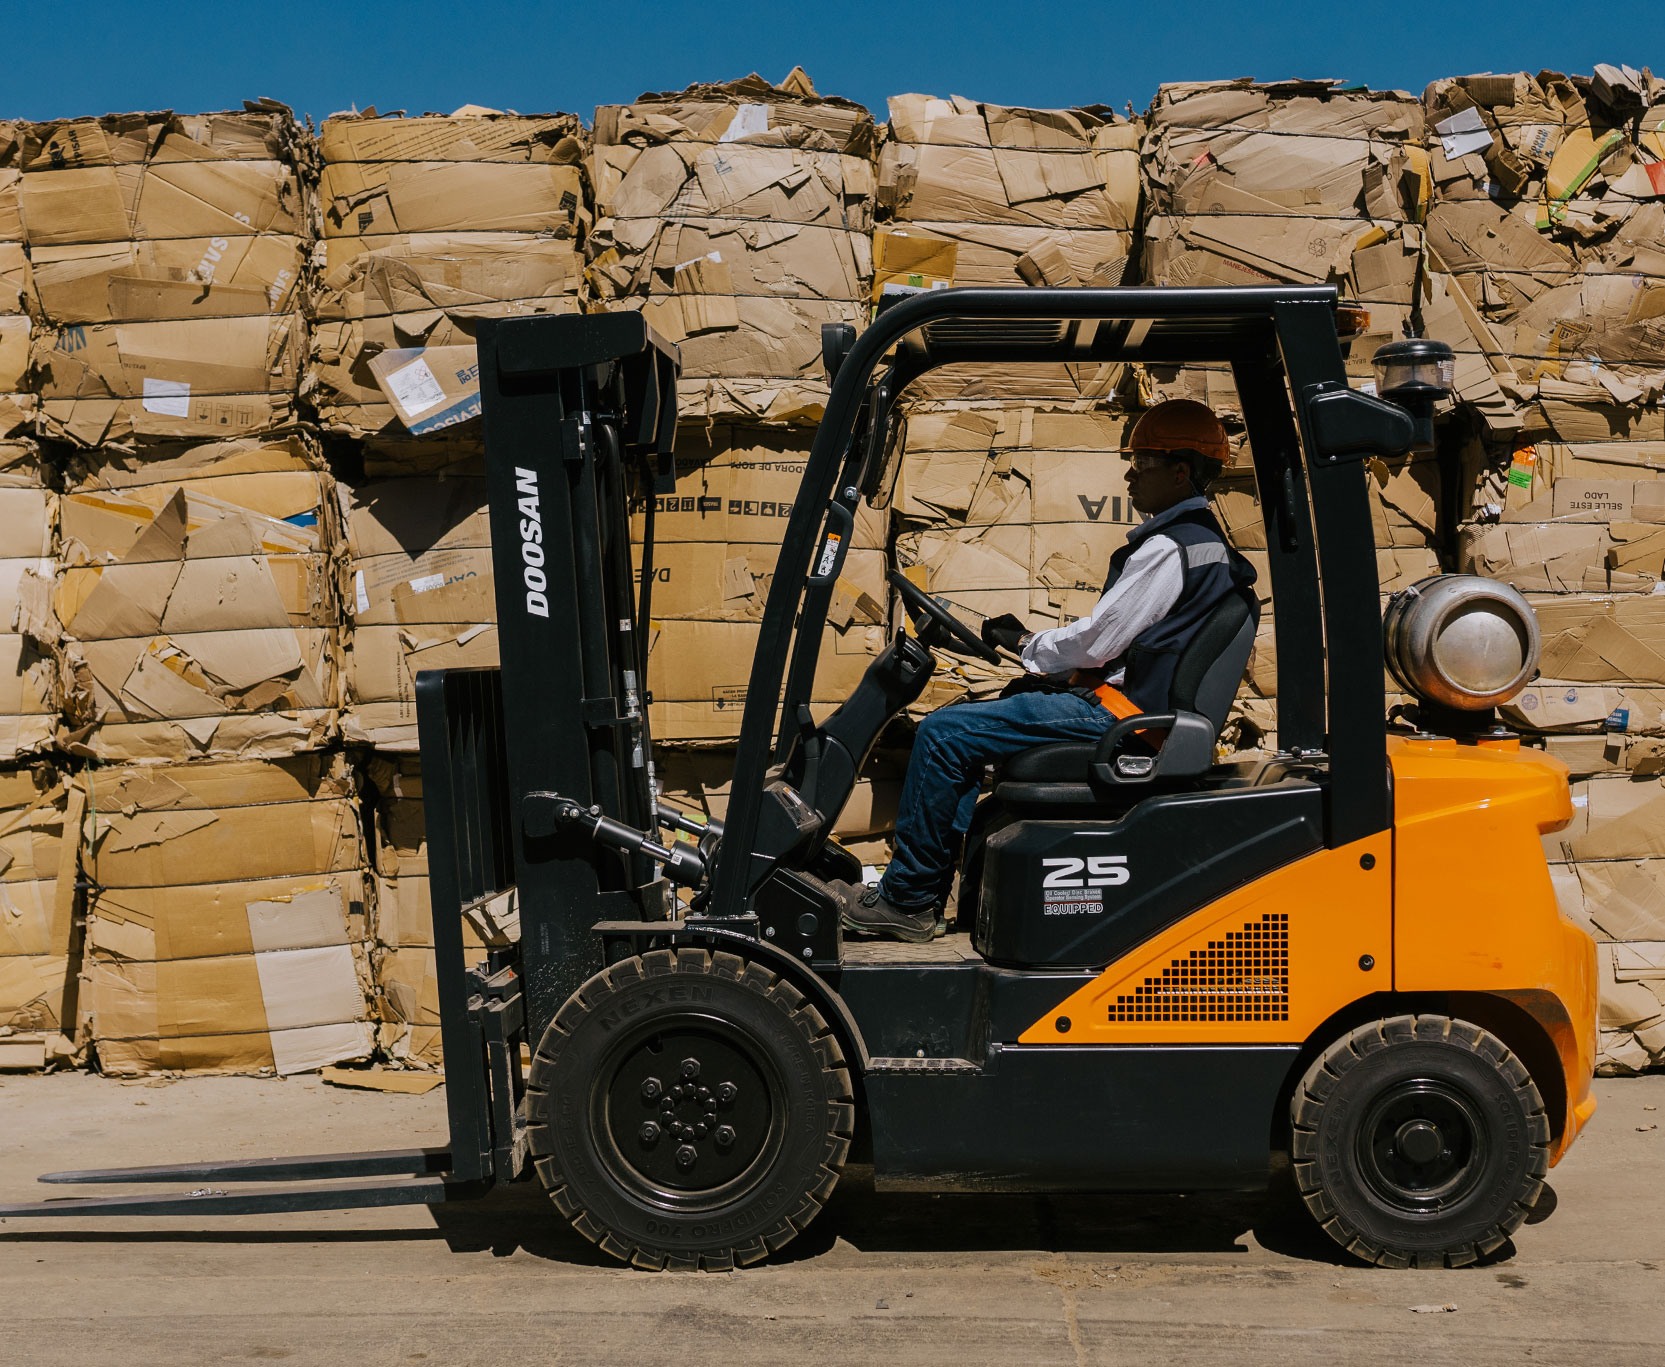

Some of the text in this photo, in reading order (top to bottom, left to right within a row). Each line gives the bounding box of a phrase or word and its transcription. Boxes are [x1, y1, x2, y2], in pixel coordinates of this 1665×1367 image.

[1570, 501, 1623, 511] SELLE ESTE
[1584, 491, 1609, 500] LADO
[515, 466, 549, 618] DOOSAN
[1042, 855, 1131, 888] 25
[1043, 902, 1104, 916] EQUIPPED
[599, 984, 714, 1033] NEXEN
[1324, 1095, 1349, 1187] NEXEN
[645, 1218, 682, 1239] 700
